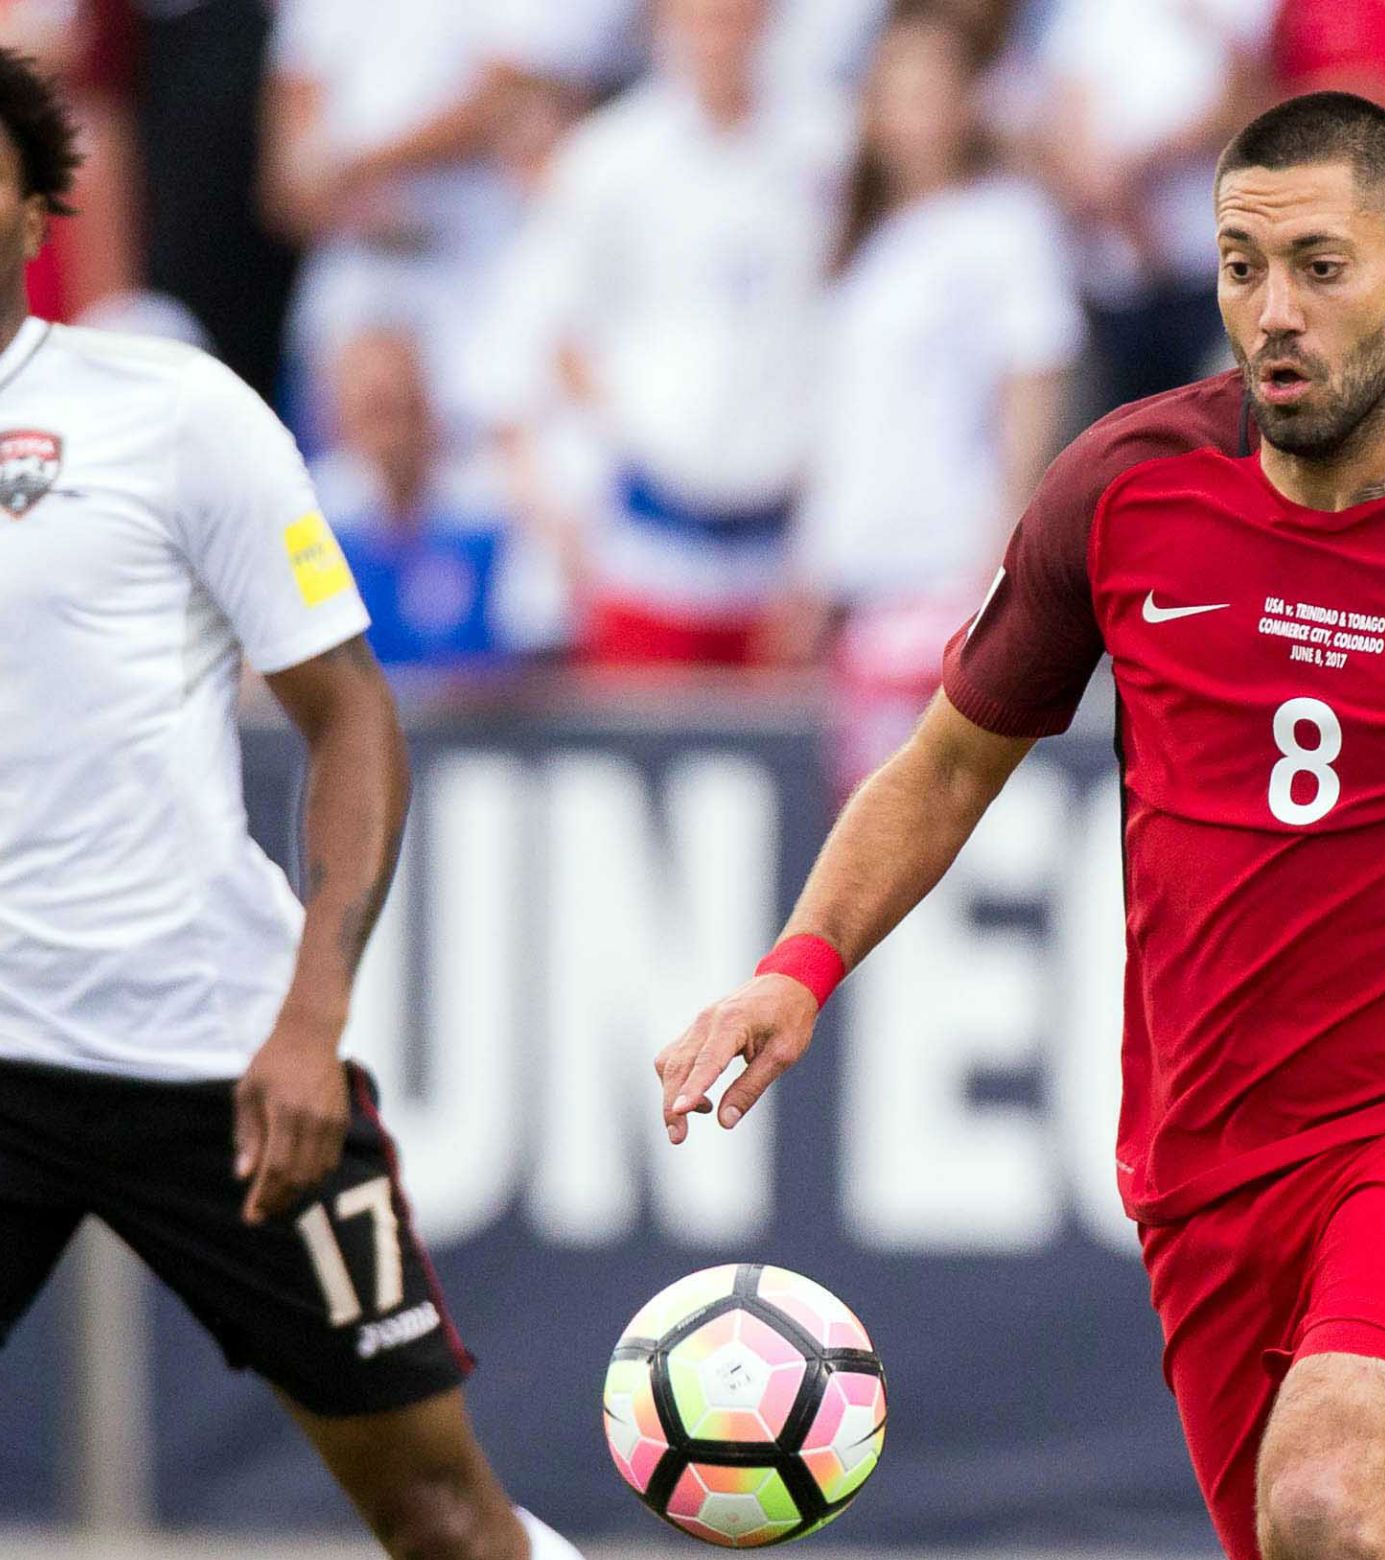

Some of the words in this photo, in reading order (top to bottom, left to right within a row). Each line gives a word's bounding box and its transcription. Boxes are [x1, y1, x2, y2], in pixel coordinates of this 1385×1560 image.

[1264, 597, 1285, 614] USA
[1295, 603, 1339, 625] TRINIDAD
[1338, 611, 1346, 627] &
[1258, 617, 1311, 640] COMMERCE
[1310, 627, 1332, 647] CITY,
[1333, 632, 1385, 654] COLORADO
[1290, 645, 1314, 663] JUNE
[1314, 649, 1323, 667] 8,
[1324, 651, 1348, 668] 2017
[1268, 697, 1342, 826] 8
[297, 1176, 404, 1328] 17
